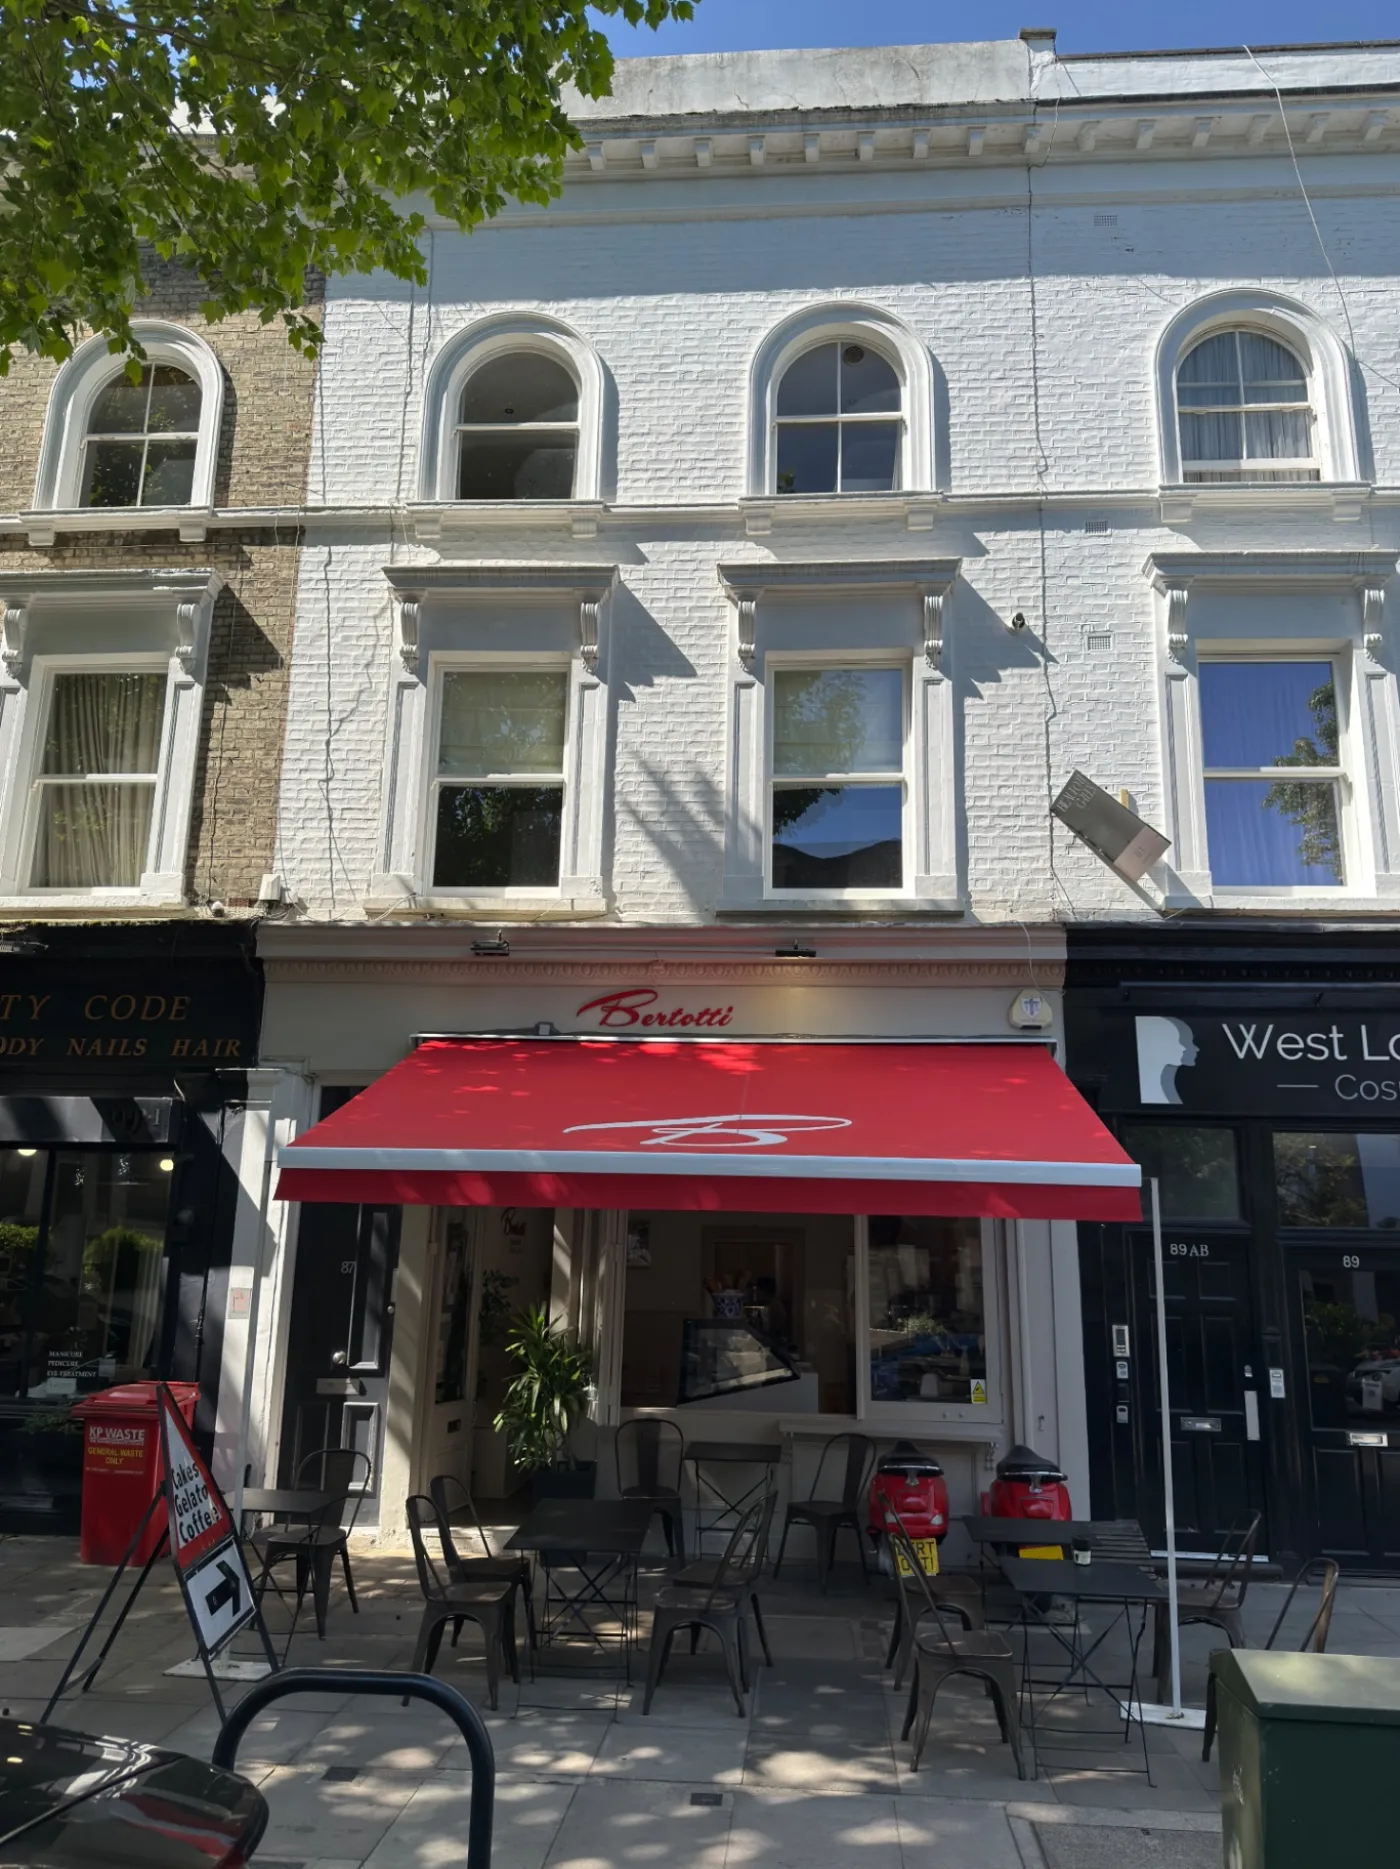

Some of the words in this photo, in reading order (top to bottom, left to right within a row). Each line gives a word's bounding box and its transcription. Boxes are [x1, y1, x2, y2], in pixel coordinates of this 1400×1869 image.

[84, 994, 193, 1021] CODE
[576, 989, 733, 1027] Bertotti
[66, 1038, 149, 1057] NAILS
[170, 1038, 242, 1058] HAIR
[1222, 1023, 1348, 1061] West
[1334, 1073, 1400, 1101] Cos
[340, 1260, 356, 1274] 87
[1342, 1255, 1360, 1268] 89
[48, 1350, 83, 1358] MANICURE
[89, 1425, 103, 1438] KP
[105, 1427, 145, 1440] WASTE
[87, 1447, 119, 1456] GENERAL
[120, 1448, 144, 1458] WASTE
[104, 1456, 125, 1465] ONLY
[174, 1484, 209, 1518] Gelato
